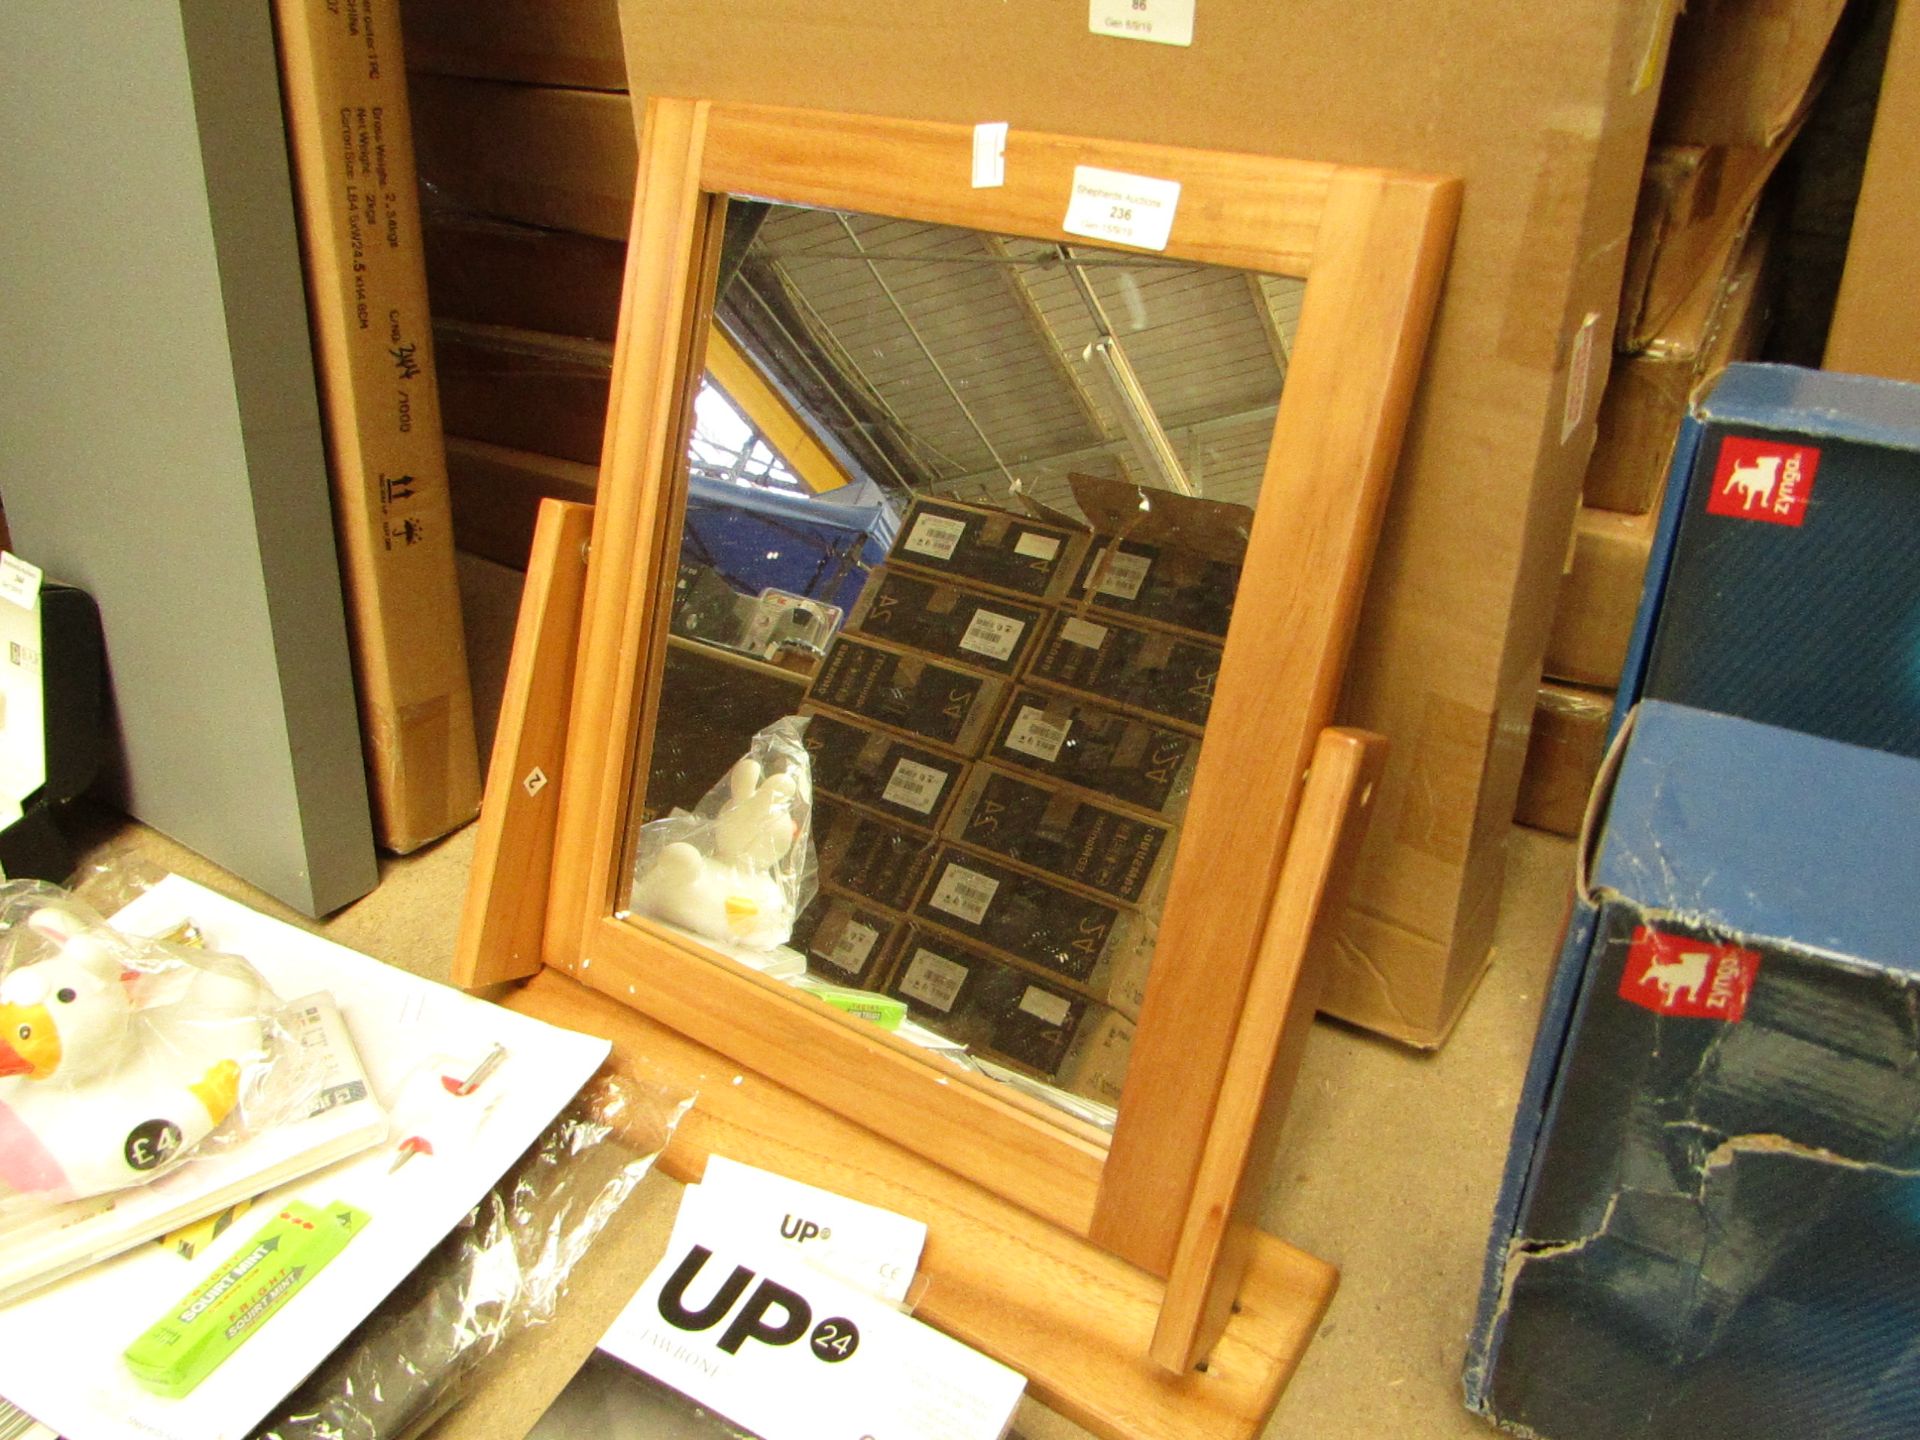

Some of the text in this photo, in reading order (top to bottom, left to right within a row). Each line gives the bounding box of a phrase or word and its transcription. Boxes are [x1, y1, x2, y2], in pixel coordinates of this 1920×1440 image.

[1110, 205, 1132, 221] 236
[1773, 458, 1801, 515] zynga
[131, 1127, 178, 1165] £4
[181, 1275, 236, 1322] SQUIRT
[233, 1245, 270, 1277] MINT
[226, 1296, 270, 1338] SQUIRT
[267, 1274, 297, 1299] MINT
[657, 1244, 853, 1356] UP 24
